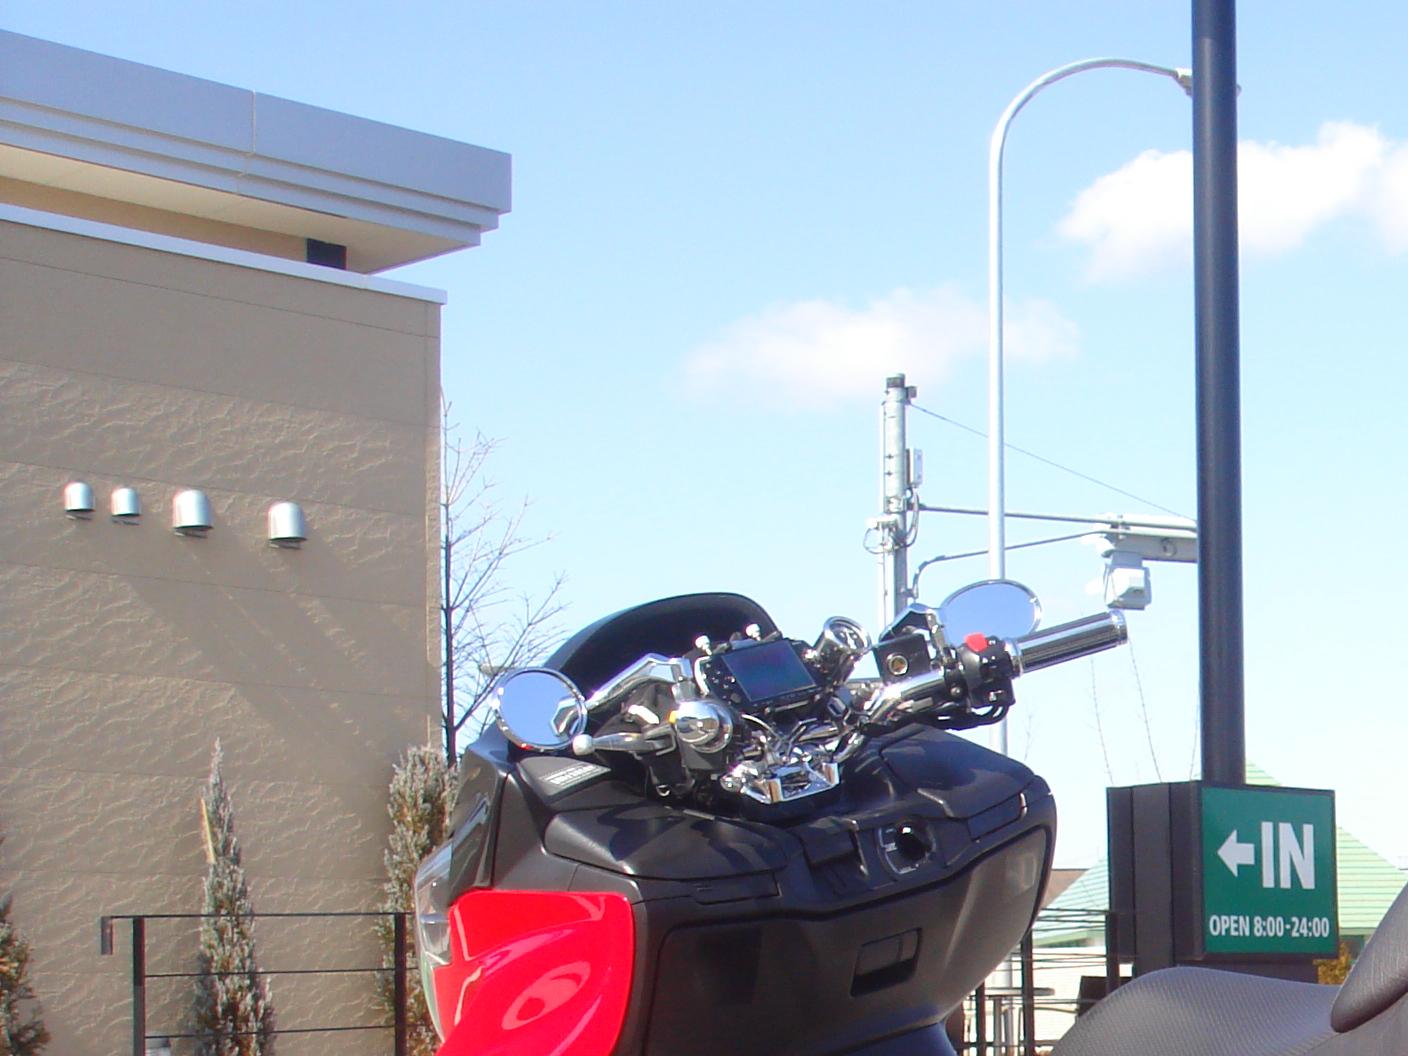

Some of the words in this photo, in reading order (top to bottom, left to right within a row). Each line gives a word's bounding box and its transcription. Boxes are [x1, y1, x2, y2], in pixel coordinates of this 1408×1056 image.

[1260, 821, 1316, 890] IN
[1209, 914, 1250, 937] OPEN
[1254, 915, 1330, 938] 8:00-24:00
